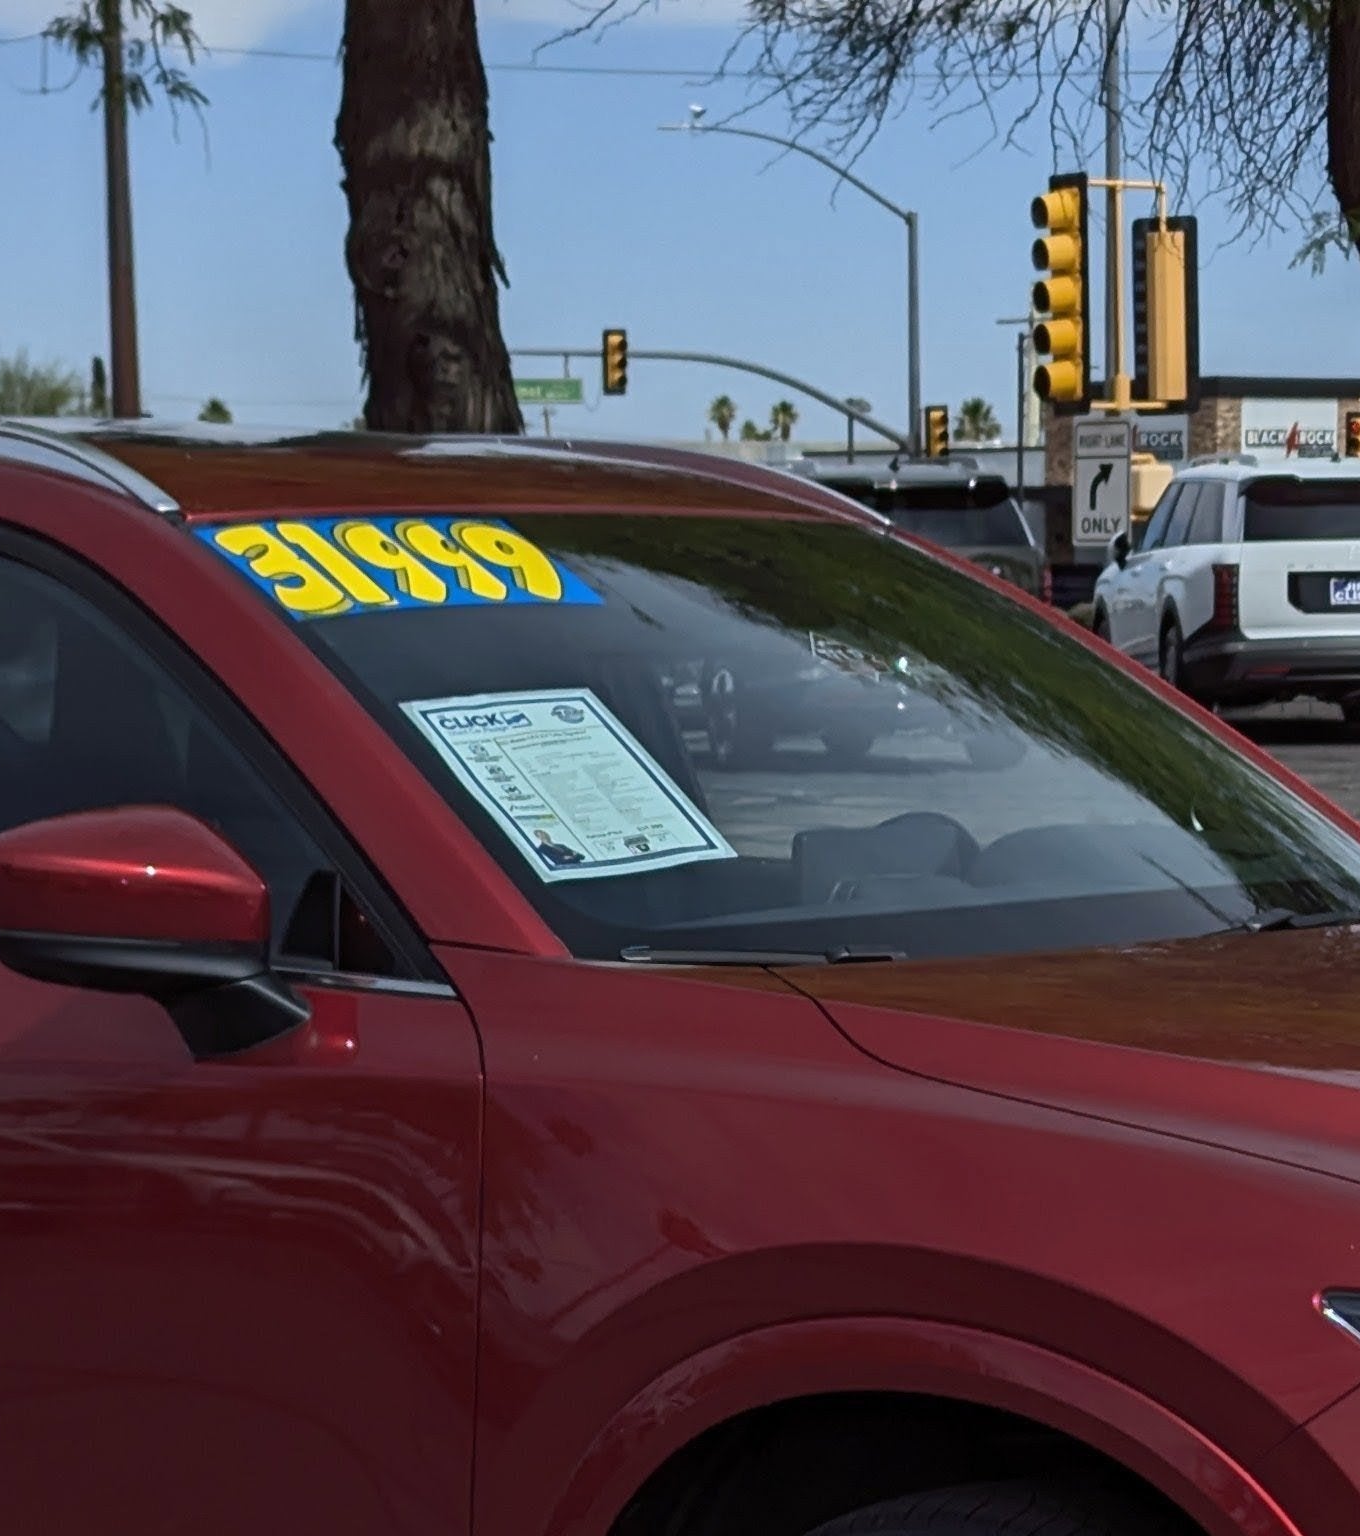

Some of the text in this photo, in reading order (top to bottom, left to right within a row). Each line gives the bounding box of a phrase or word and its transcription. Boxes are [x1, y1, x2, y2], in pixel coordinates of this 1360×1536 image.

[1139, 433, 1179, 446] ROCK
[1247, 430, 1332, 445] BLACK ROCK
[1081, 518, 1121, 534] ONLY
[214, 519, 563, 616] 31999
[438, 713, 506, 731] CLICK
